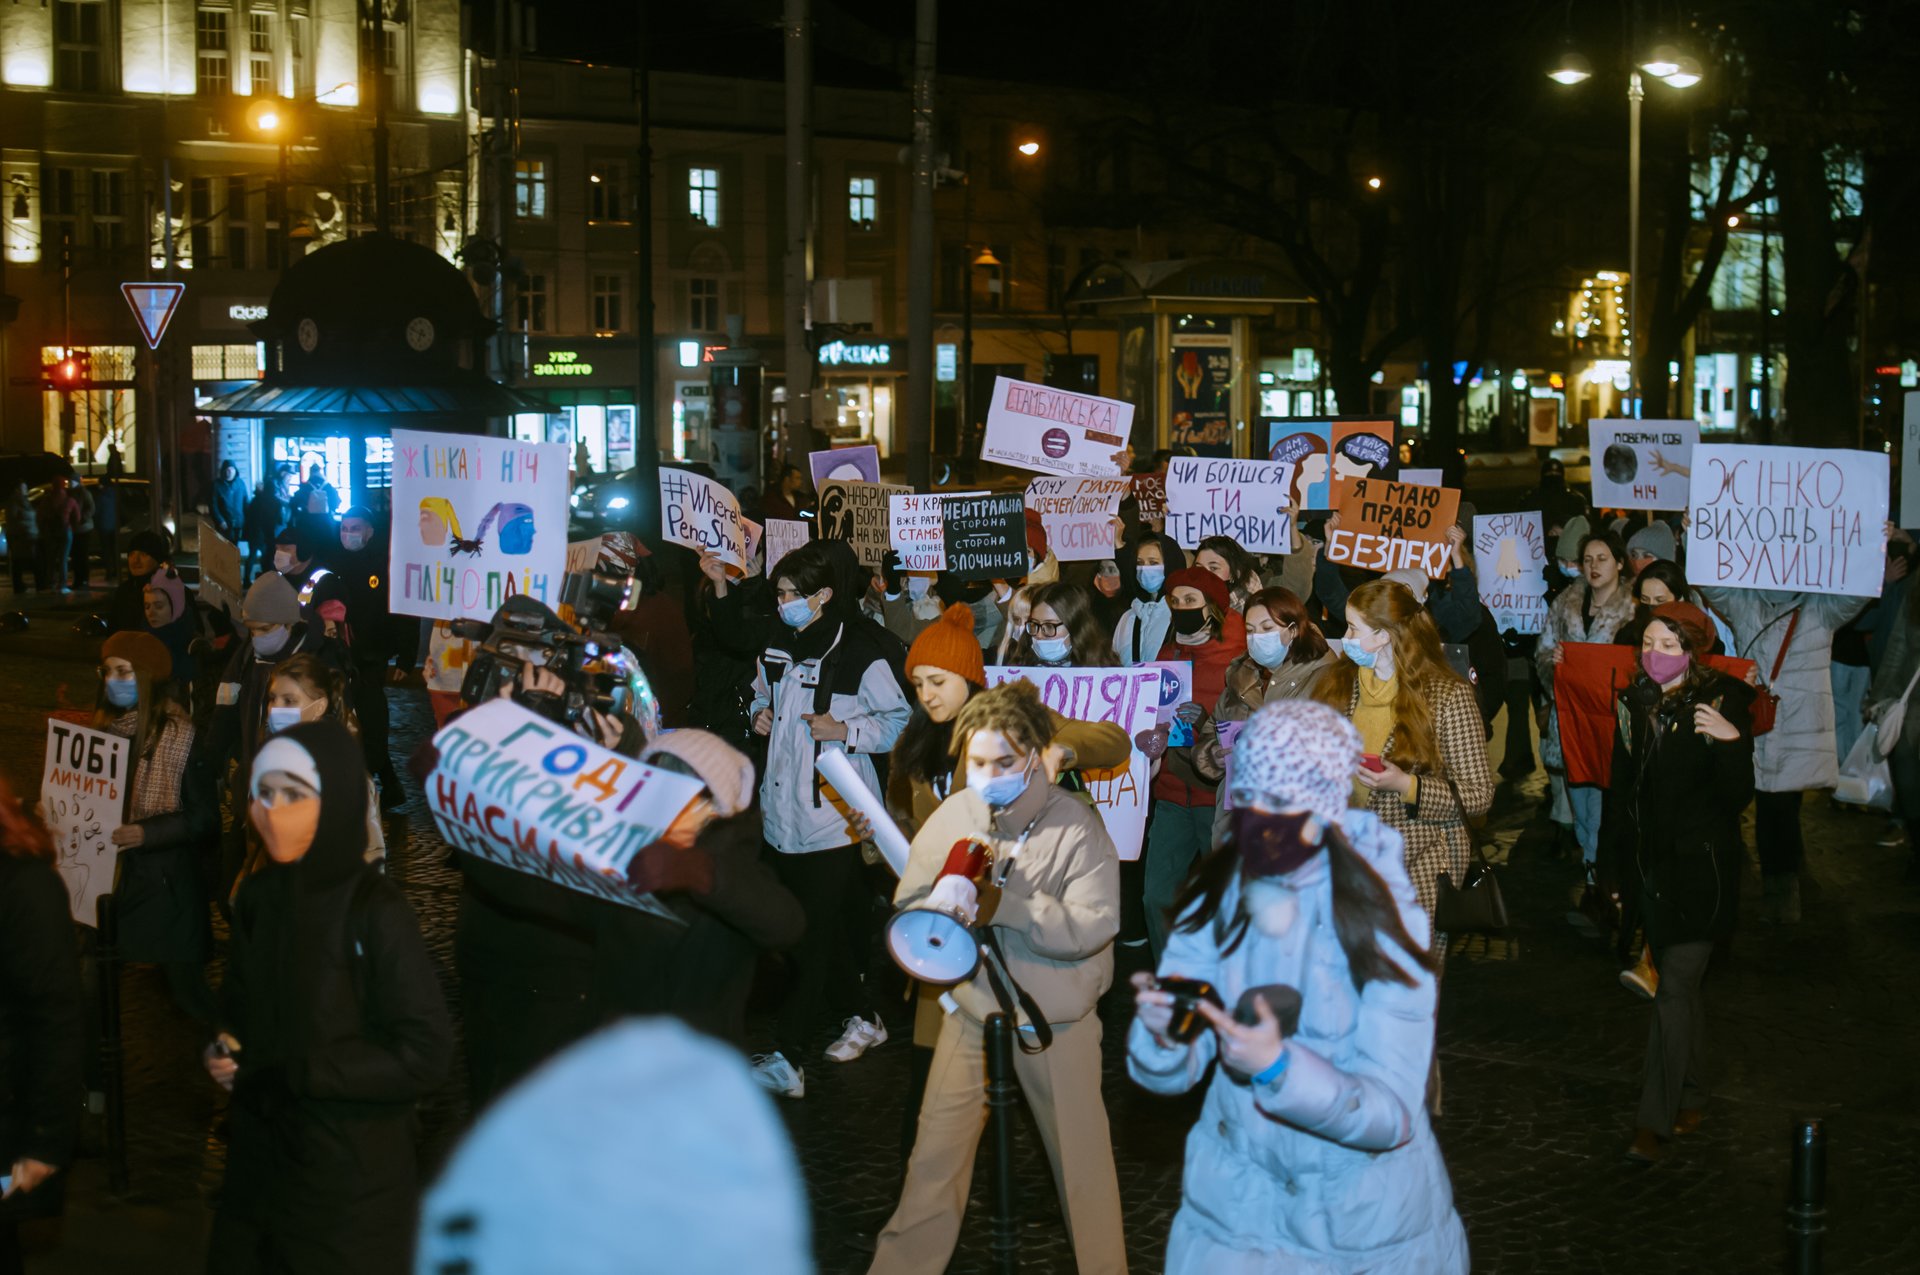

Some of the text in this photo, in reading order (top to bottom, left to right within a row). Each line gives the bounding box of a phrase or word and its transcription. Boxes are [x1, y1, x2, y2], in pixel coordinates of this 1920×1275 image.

[549, 352, 577, 363] УКР
[534, 364, 593, 376] ЗОЛОТО
[1006, 387, 1113, 433] СТАМБУЛЬСЬКА
[1286, 437, 1302, 452] AM
[1363, 437, 1387, 455] HAVE
[1173, 461, 1284, 484] ЧИ БОЇШСЯ
[1026, 479, 1133, 500] ХОЧУ ГУЛЯТИ
[1353, 480, 1440, 508] Я МАЮ
[902, 495, 951, 512] 34 КРА
[943, 498, 1023, 521] НЕЙТРАЛЬНА
[1138, 498, 1157, 512] НЕ
[1206, 488, 1240, 513] ТИ
[856, 507, 890, 527] БОЯТ
[896, 515, 942, 526] ВЖЕ РАТИ
[952, 517, 1006, 531] СТОРОНА
[1361, 502, 1432, 529] ПРАВО
[856, 527, 890, 544] НА ВУЛ
[898, 528, 944, 541] СТАМБУ
[1381, 526, 1404, 539] НА
[1695, 507, 1861, 547] ВИХОДЬ НА
[955, 536, 1006, 549] СТОРОНА
[1475, 515, 1544, 560] НАБРИДЛО
[916, 543, 945, 552] КОНВЕ
[905, 554, 940, 570] КОЛИ
[948, 551, 1022, 572] ЗЛОЧИНЦЯ
[1328, 540, 1452, 578] БЕЗПЕКУ
[1717, 541, 1848, 590] ВУЛИЦІ!
[50, 768, 118, 800] ЛИЧИТЬ
